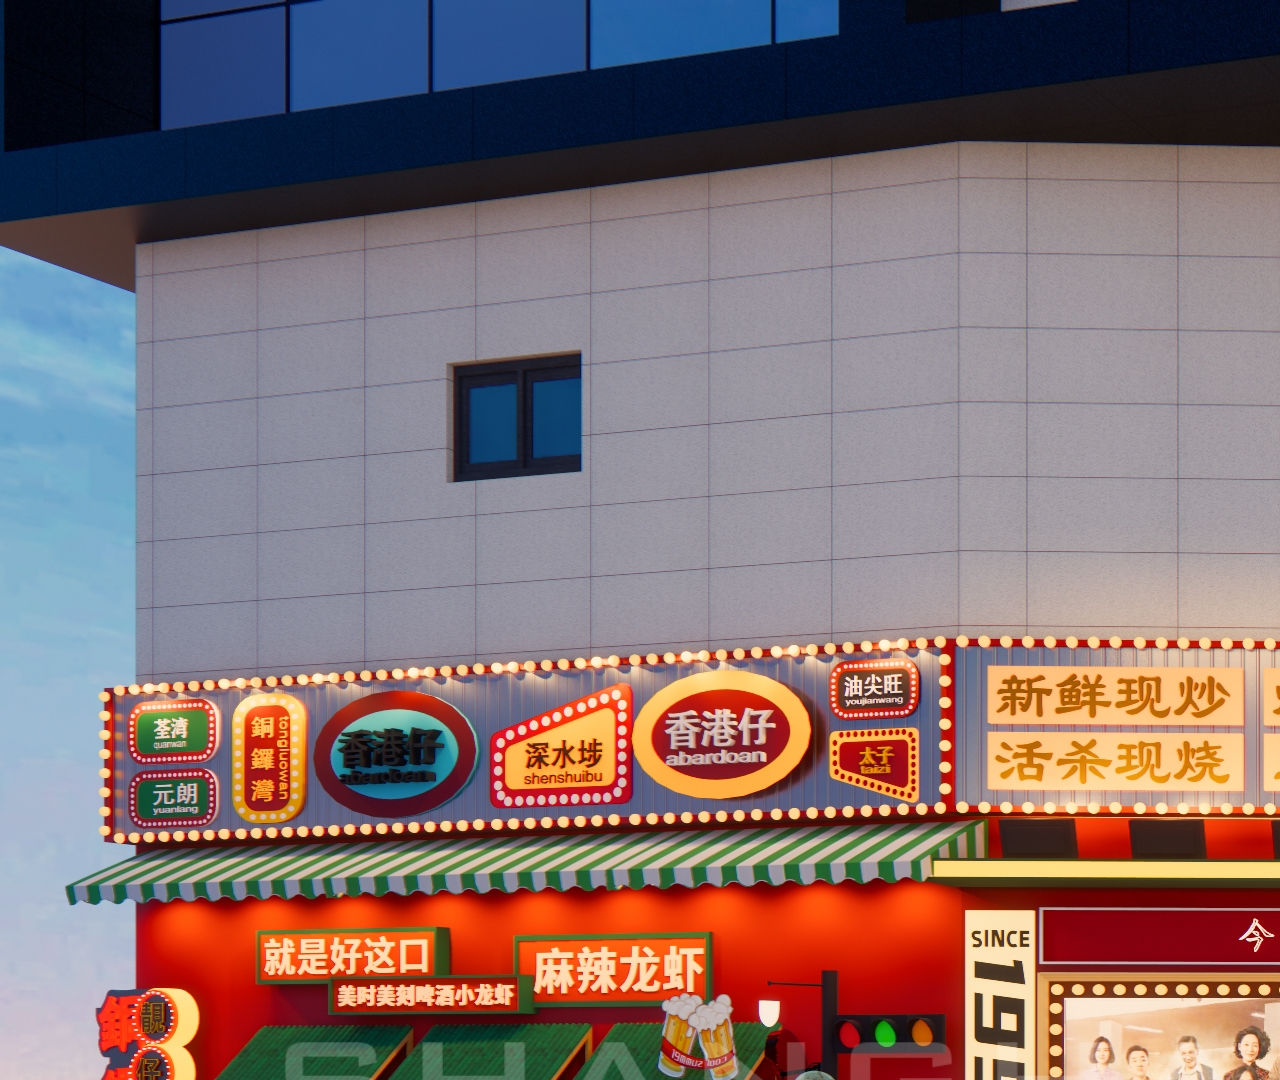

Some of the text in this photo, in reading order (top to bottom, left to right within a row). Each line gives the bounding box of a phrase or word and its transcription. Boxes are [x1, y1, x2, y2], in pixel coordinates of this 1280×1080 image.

[843, 673, 903, 697] 油尖旺
[996, 674, 1231, 718] 新鲜现炒
[845, 696, 904, 707] youjianwang
[153, 717, 189, 739] 荃湾
[664, 707, 776, 750] 香港仔
[250, 716, 276, 803] 銅鑼灣
[277, 715, 290, 800] tongluowan
[337, 727, 445, 769] 香港仔
[525, 738, 603, 770] 深水埗
[665, 749, 768, 766] abardoan
[858, 745, 895, 765] 太子
[859, 763, 891, 775] taizi
[995, 739, 1231, 784] 活杀现烧
[524, 770, 603, 785] shenshuibu
[152, 783, 199, 806] 元朗
[152, 805, 199, 816] yuanlang
[971, 930, 1030, 948] SINCE
[263, 937, 430, 976] 就是好这口
[533, 946, 705, 995] 麻辣龙虾
[337, 983, 515, 1008] 美时美刻啤酒小龙虾
